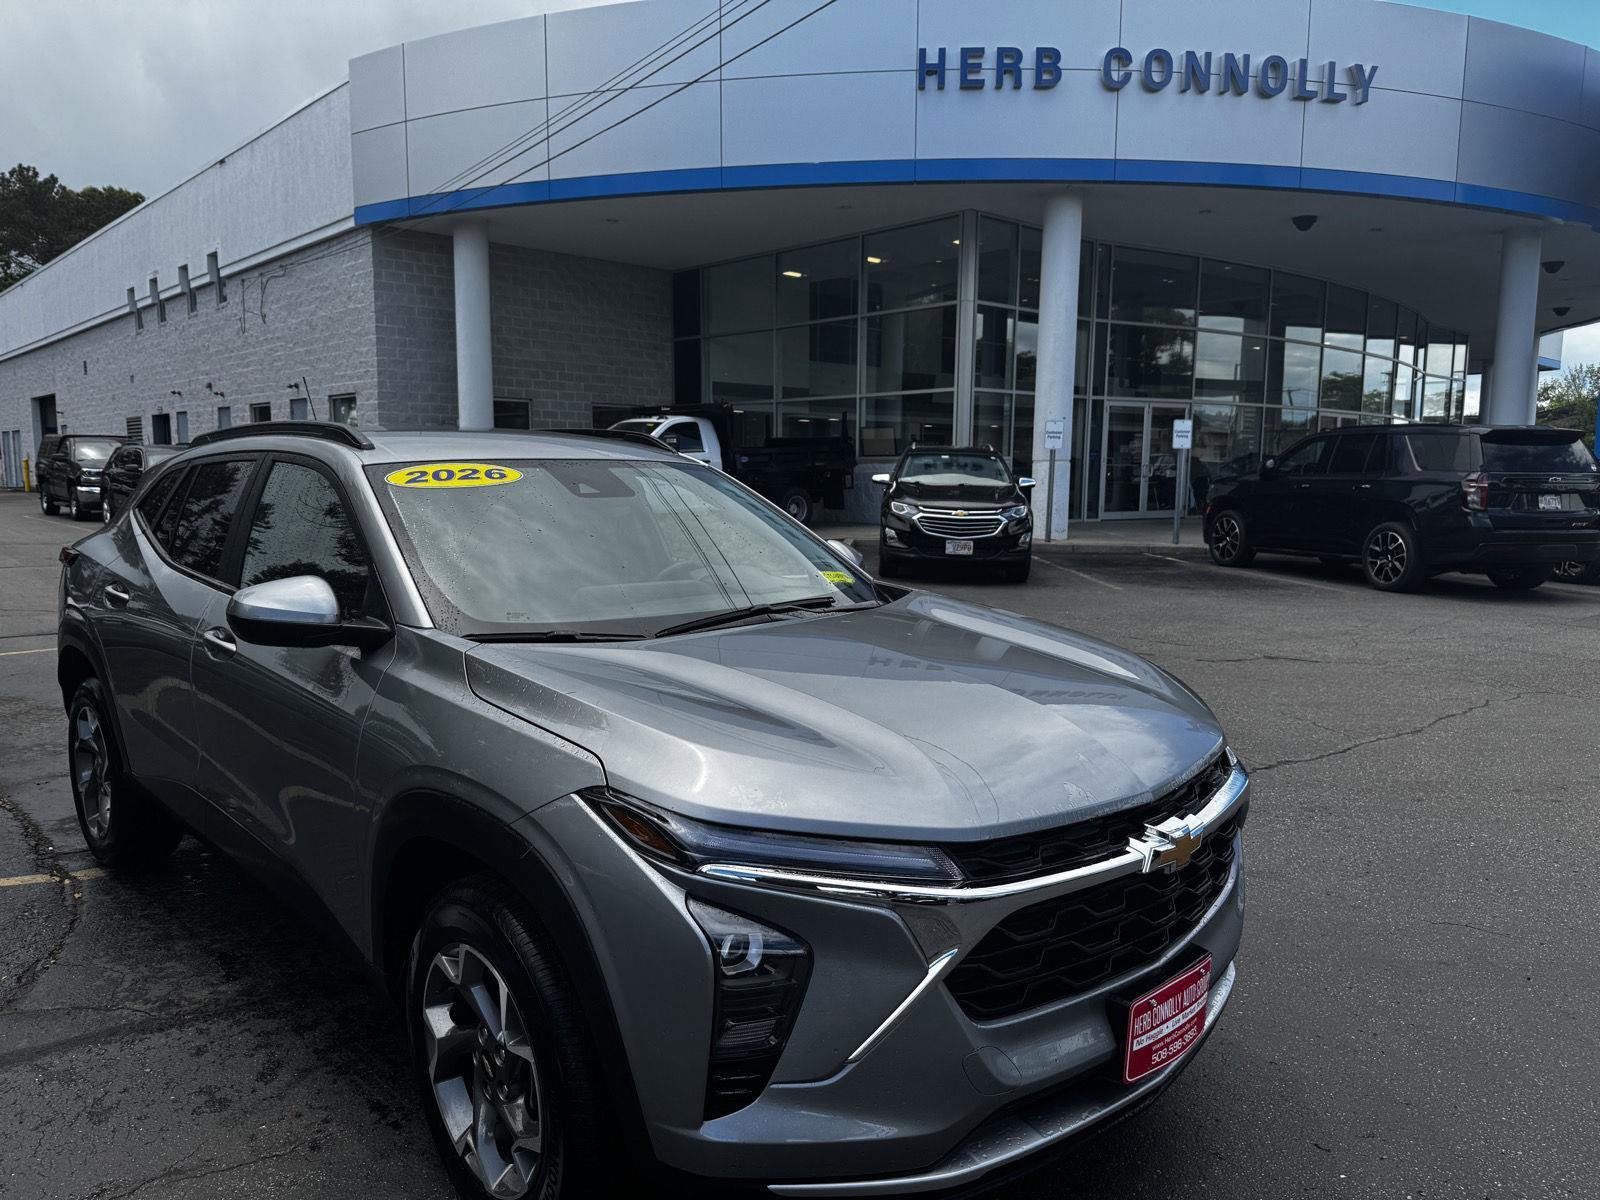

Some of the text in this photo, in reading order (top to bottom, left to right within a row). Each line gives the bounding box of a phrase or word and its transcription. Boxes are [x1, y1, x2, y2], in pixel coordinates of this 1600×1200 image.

[917, 46, 1379, 105] HERB CONNOLLY
[405, 468, 507, 484] 2026
[1134, 1010, 1152, 1036] HERB
[1153, 992, 1182, 1026] CONNOLLY
[1183, 984, 1197, 1008] AUTO
[1135, 1039, 1144, 1048] No
[1146, 1028, 1164, 1042] Haggle
